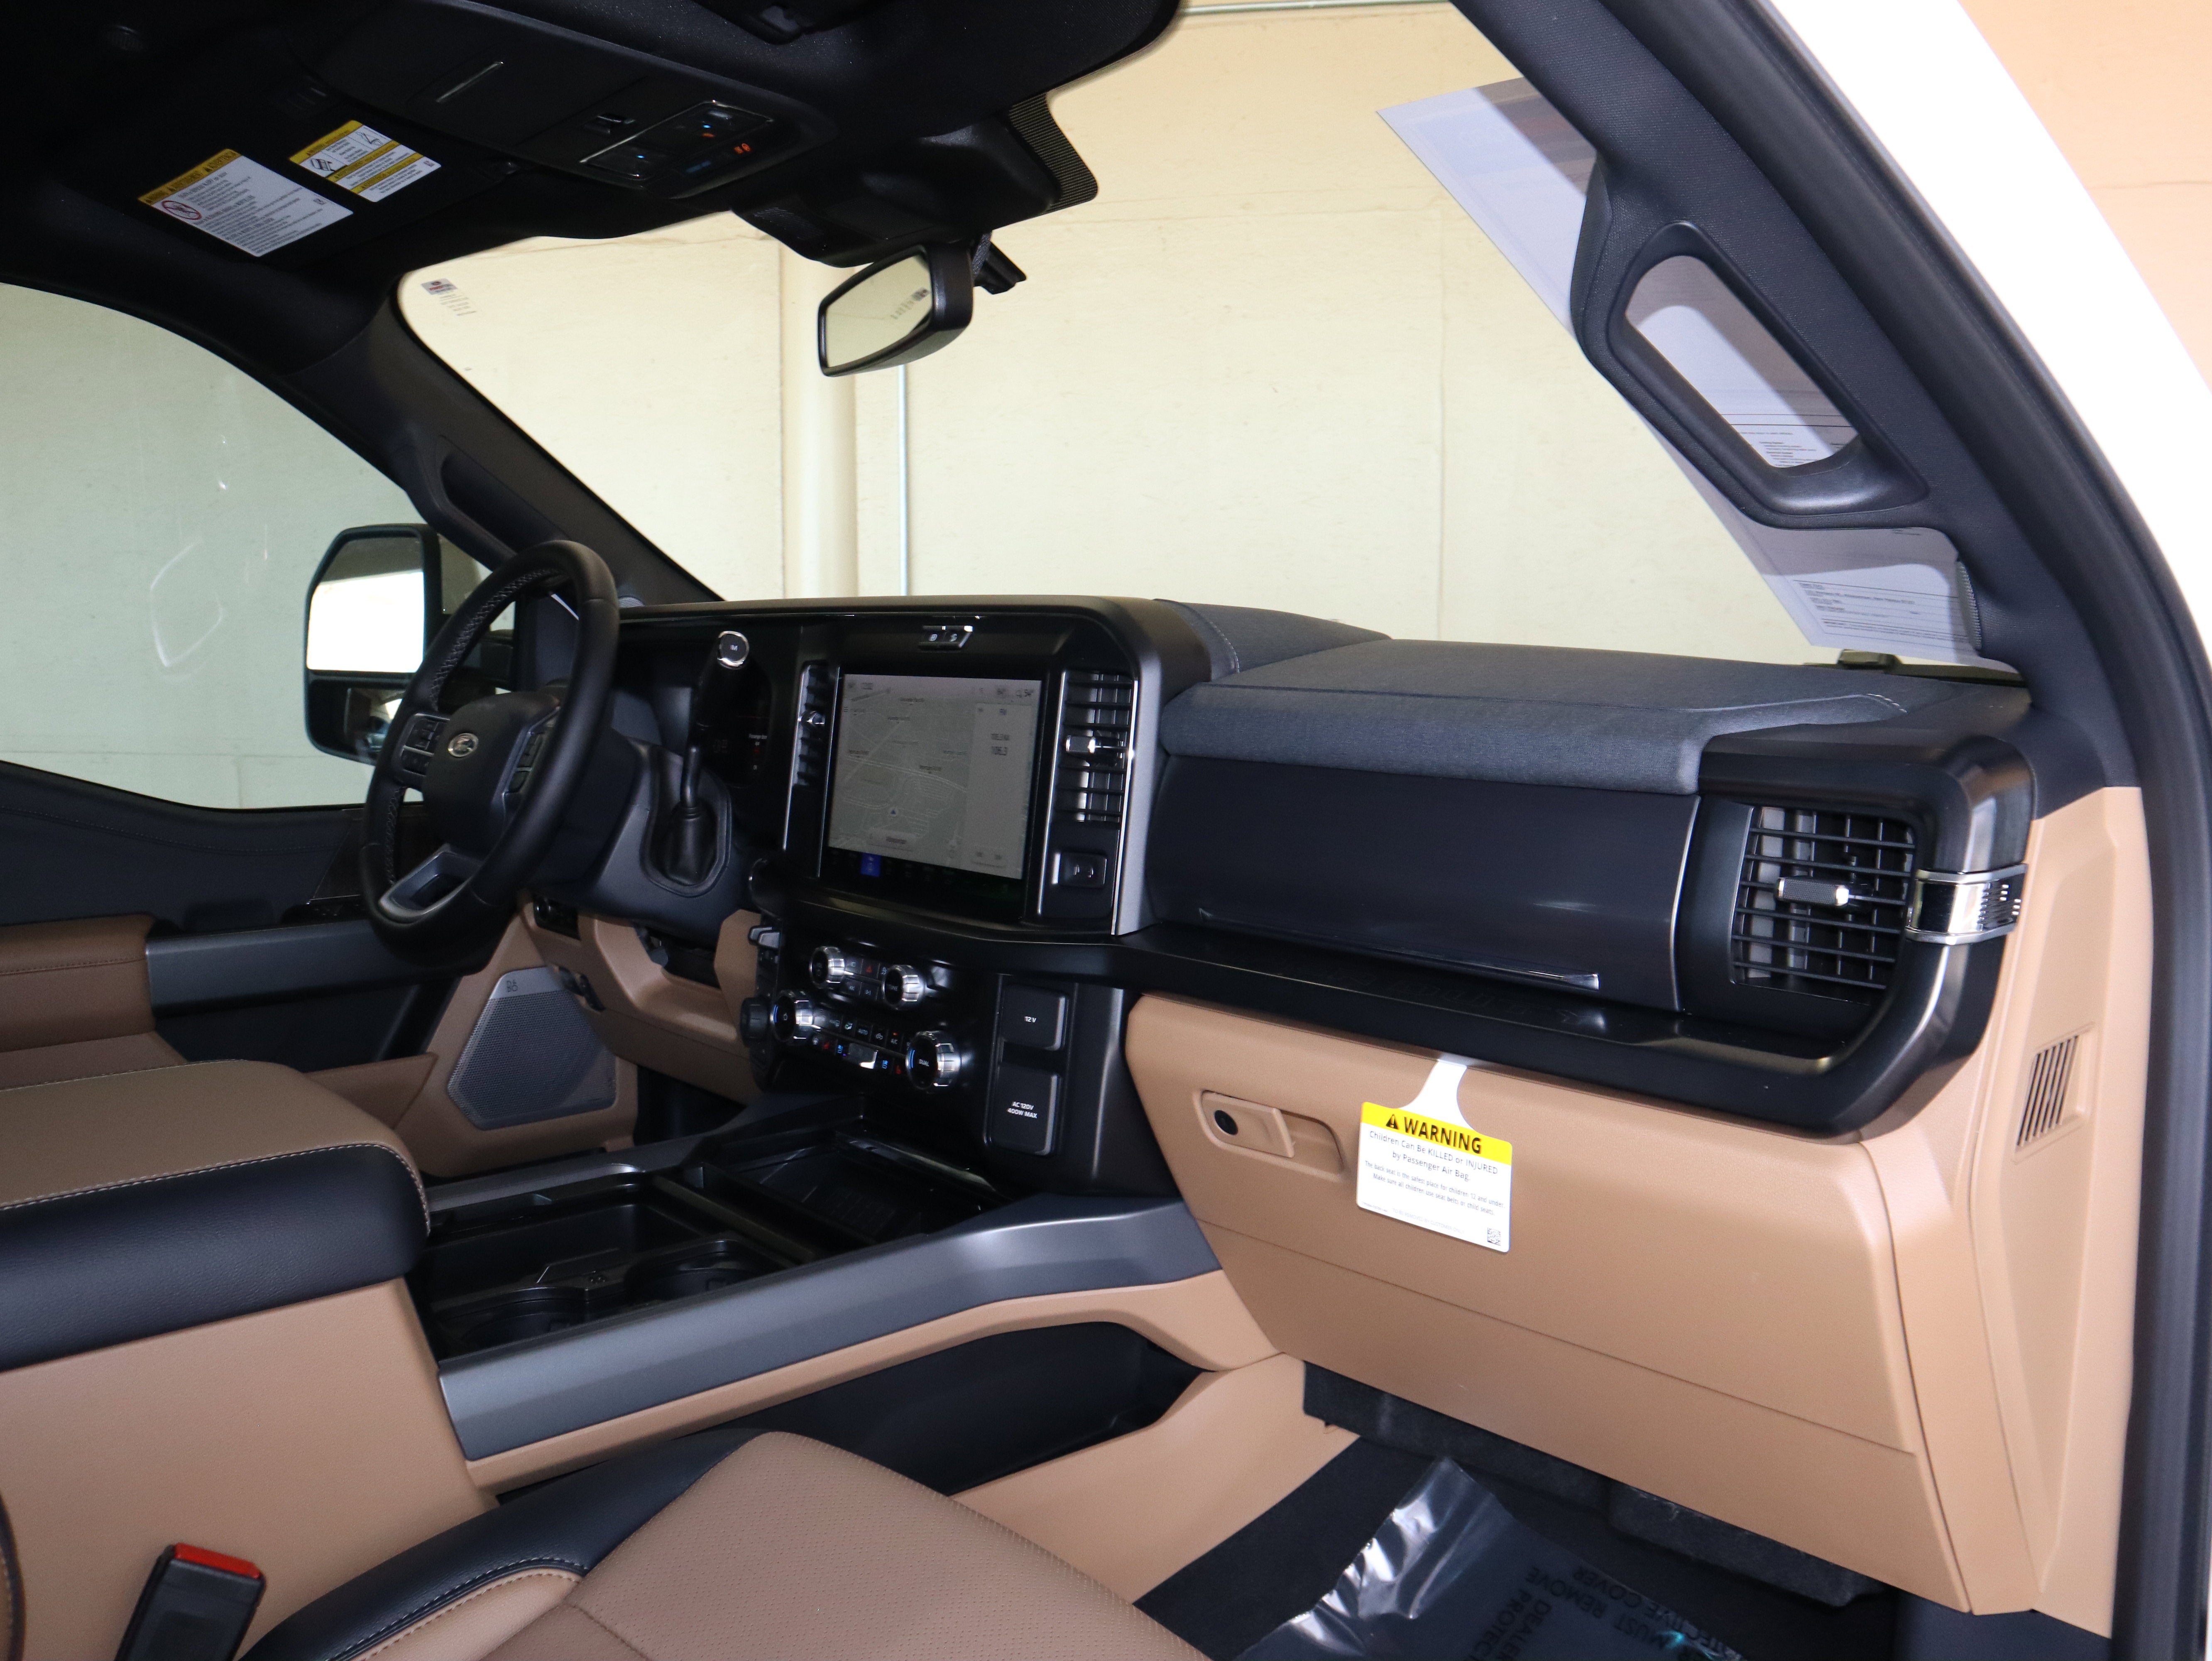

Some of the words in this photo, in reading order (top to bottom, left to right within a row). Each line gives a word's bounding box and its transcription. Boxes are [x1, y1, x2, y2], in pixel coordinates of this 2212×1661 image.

[918, 1058, 930, 1067] DUAL
[1006, 1107, 1024, 1116] 400W
[1024, 1111, 1038, 1119] MAX
[1370, 1130, 1400, 1146] Children
[1401, 1140, 1415, 1151] Can
[1417, 1145, 1426, 1154] Be
[1428, 1148, 1453, 1161] KILLED
[1466, 1159, 1498, 1174] INJURED
[1404, 1116, 1482, 1154] WARNING
[1392, 1150, 1402, 1161] by
[1403, 1154, 1440, 1171] Passenger
[1442, 1166, 1453, 1175] Air
[1455, 1169, 1471, 1182] Bag.
[1373, 1173, 1386, 1182] Make
[1405, 1183, 1425, 1194] children
[1447, 1196, 1459, 1205] belts
[1467, 1202, 1479, 1211] child
[1480, 1206, 1495, 1216] seats.
[1374, 1164, 1385, 1172] back
[1411, 1176, 1425, 1185] safest
[1427, 1181, 1439, 1189] place
[1449, 1186, 1469, 1198] children
[1489, 1199, 1505, 1209] under.
[1405, 1212, 1424, 1222] REMOVED
[1430, 1220, 1453, 1231] CUSTOMER
[1525, 1566, 1607, 1618] REMOVE
[1573, 1565, 1642, 1608] COVER
[1613, 1613, 1667, 1649] MUST
